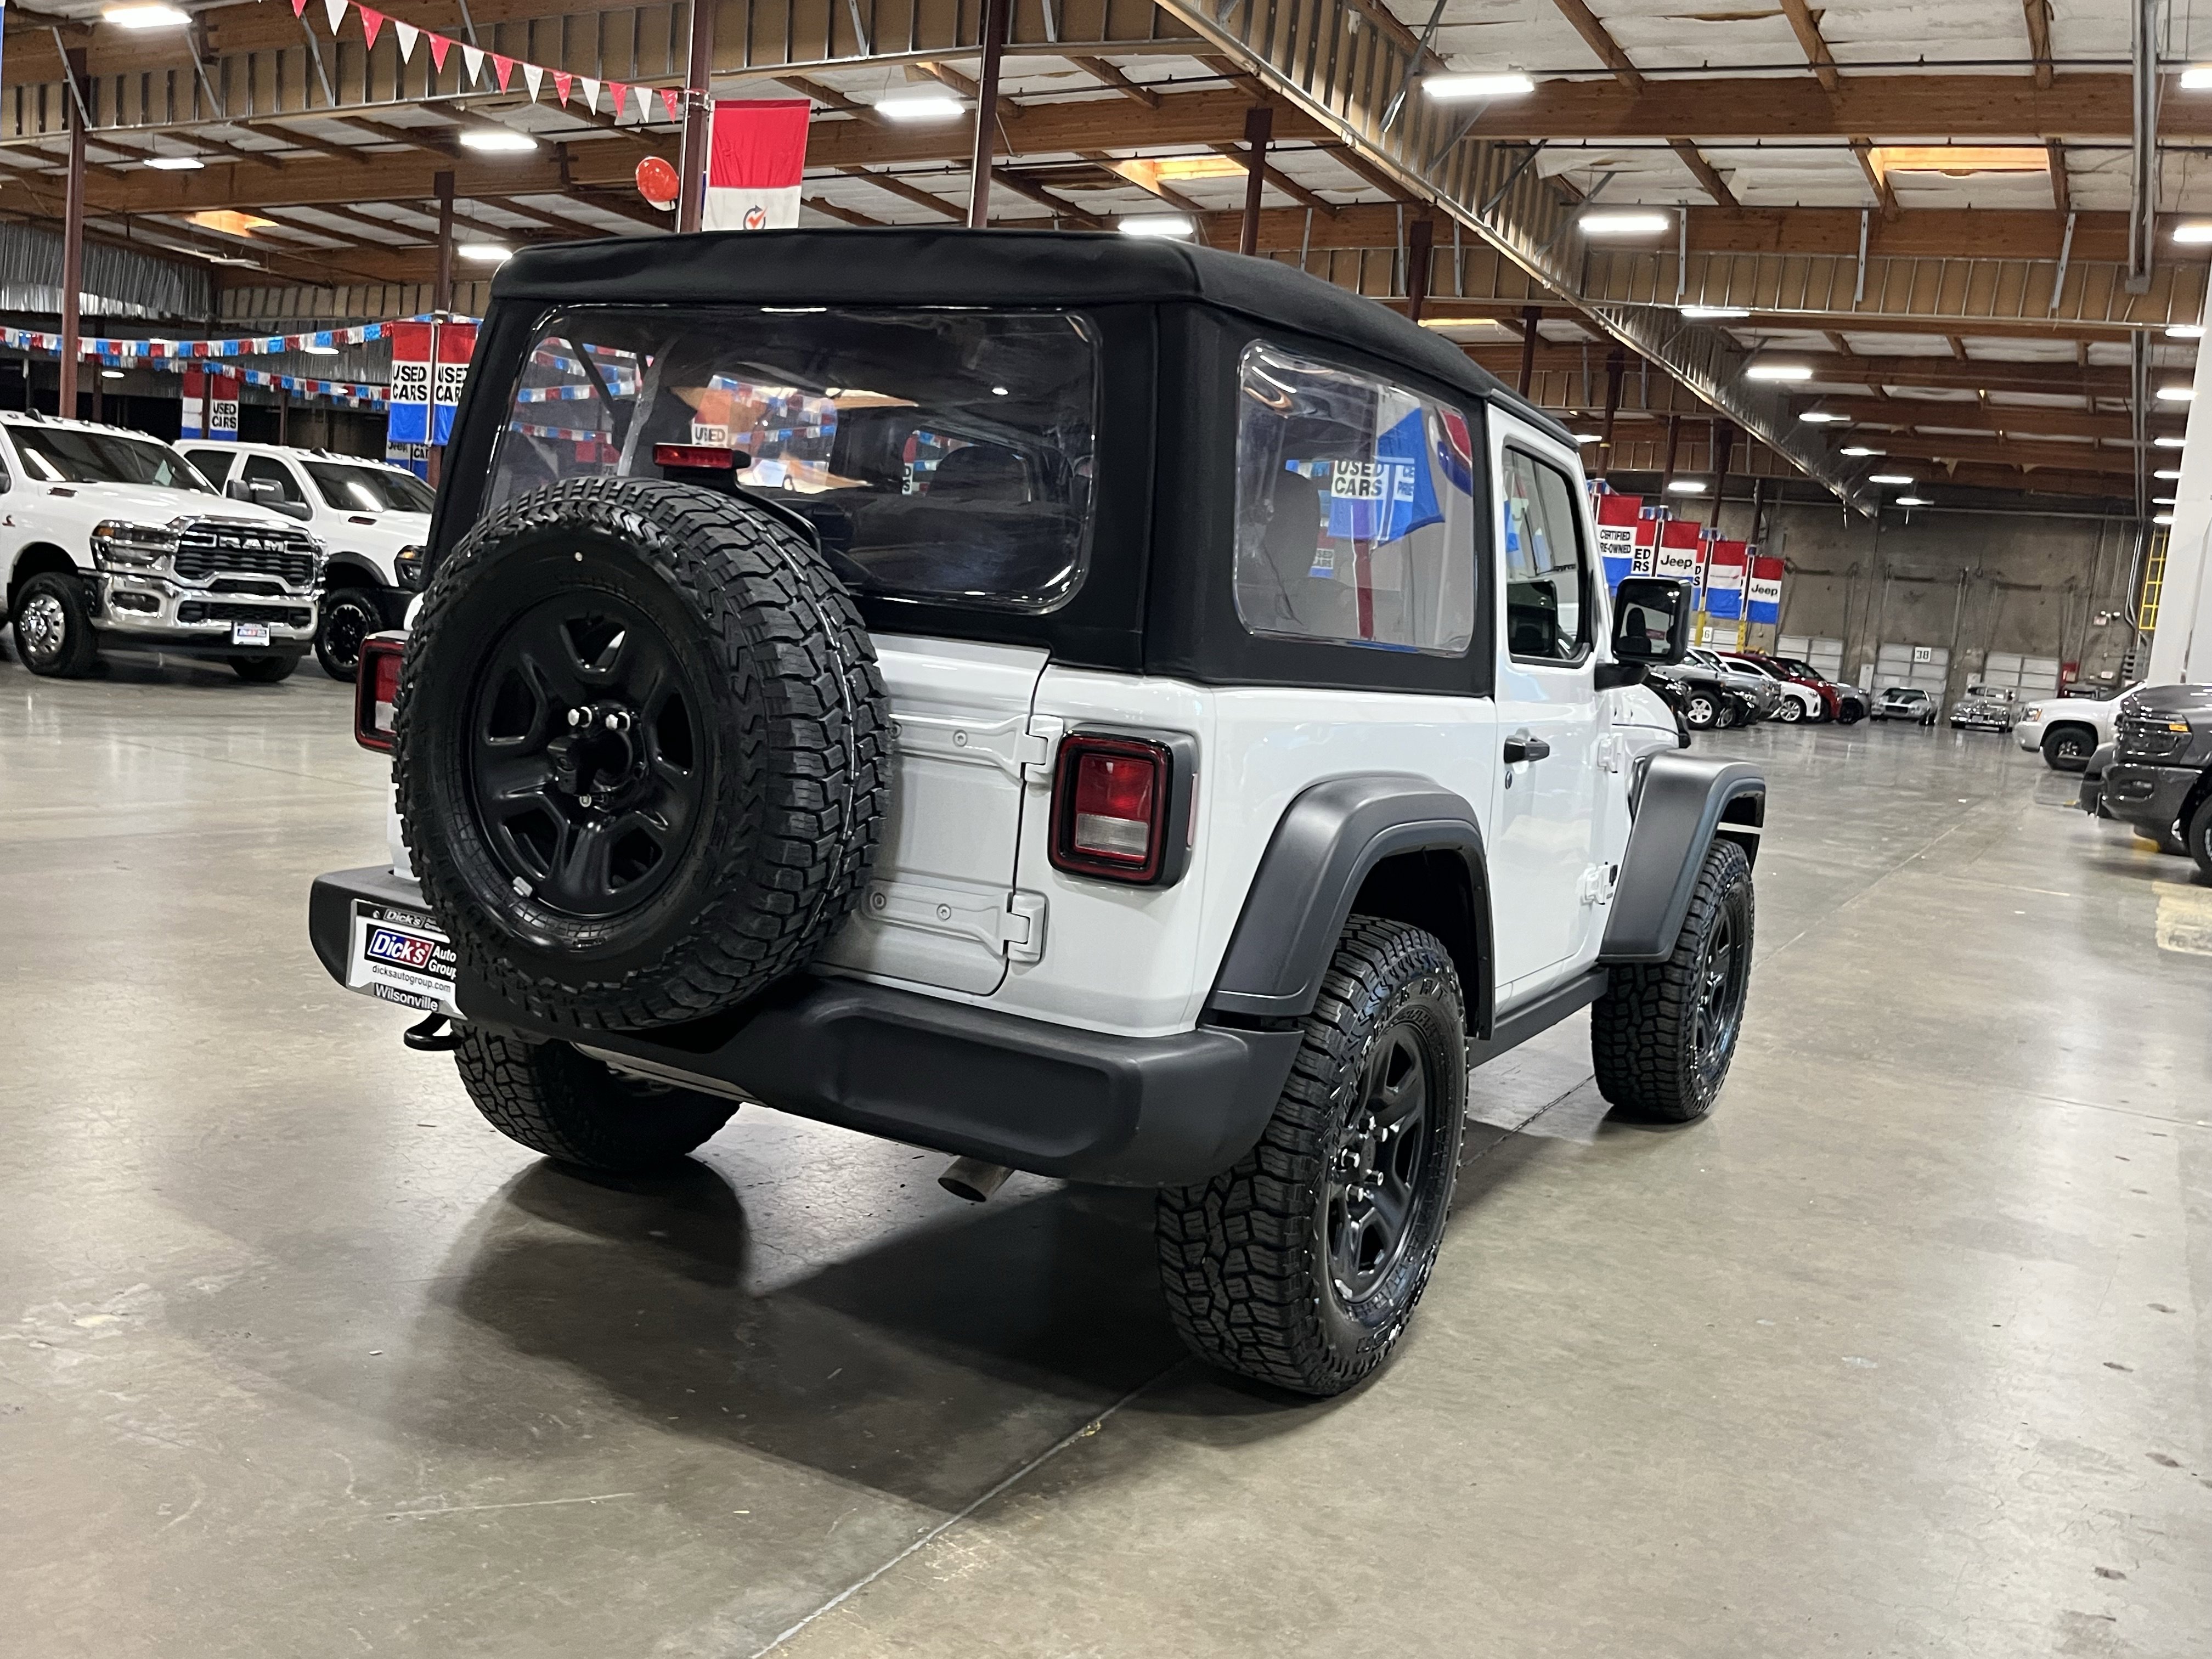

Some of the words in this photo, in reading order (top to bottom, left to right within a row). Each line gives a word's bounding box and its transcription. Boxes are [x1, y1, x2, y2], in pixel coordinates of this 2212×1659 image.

[393, 365, 427, 382] USED
[393, 383, 427, 401] CARS
[436, 385, 461, 402] CAR
[213, 402, 236, 415] USED
[1337, 460, 1384, 477] USED
[1335, 477, 1382, 496] CARS
[219, 536, 284, 552] RAM
[1600, 543, 1631, 554] RE-OWNED
[1634, 549, 1651, 559] ED
[1660, 555, 1692, 569] Jeep
[1633, 561, 1649, 572] RS
[1751, 584, 1778, 597] Jeep
[386, 911, 421, 926] Dick's
[373, 934, 430, 963] Dick's
[432, 946, 456, 962] Auto
[373, 965, 451, 992] dicksautogroup.com
[375, 984, 438, 1011] Wilsonville
